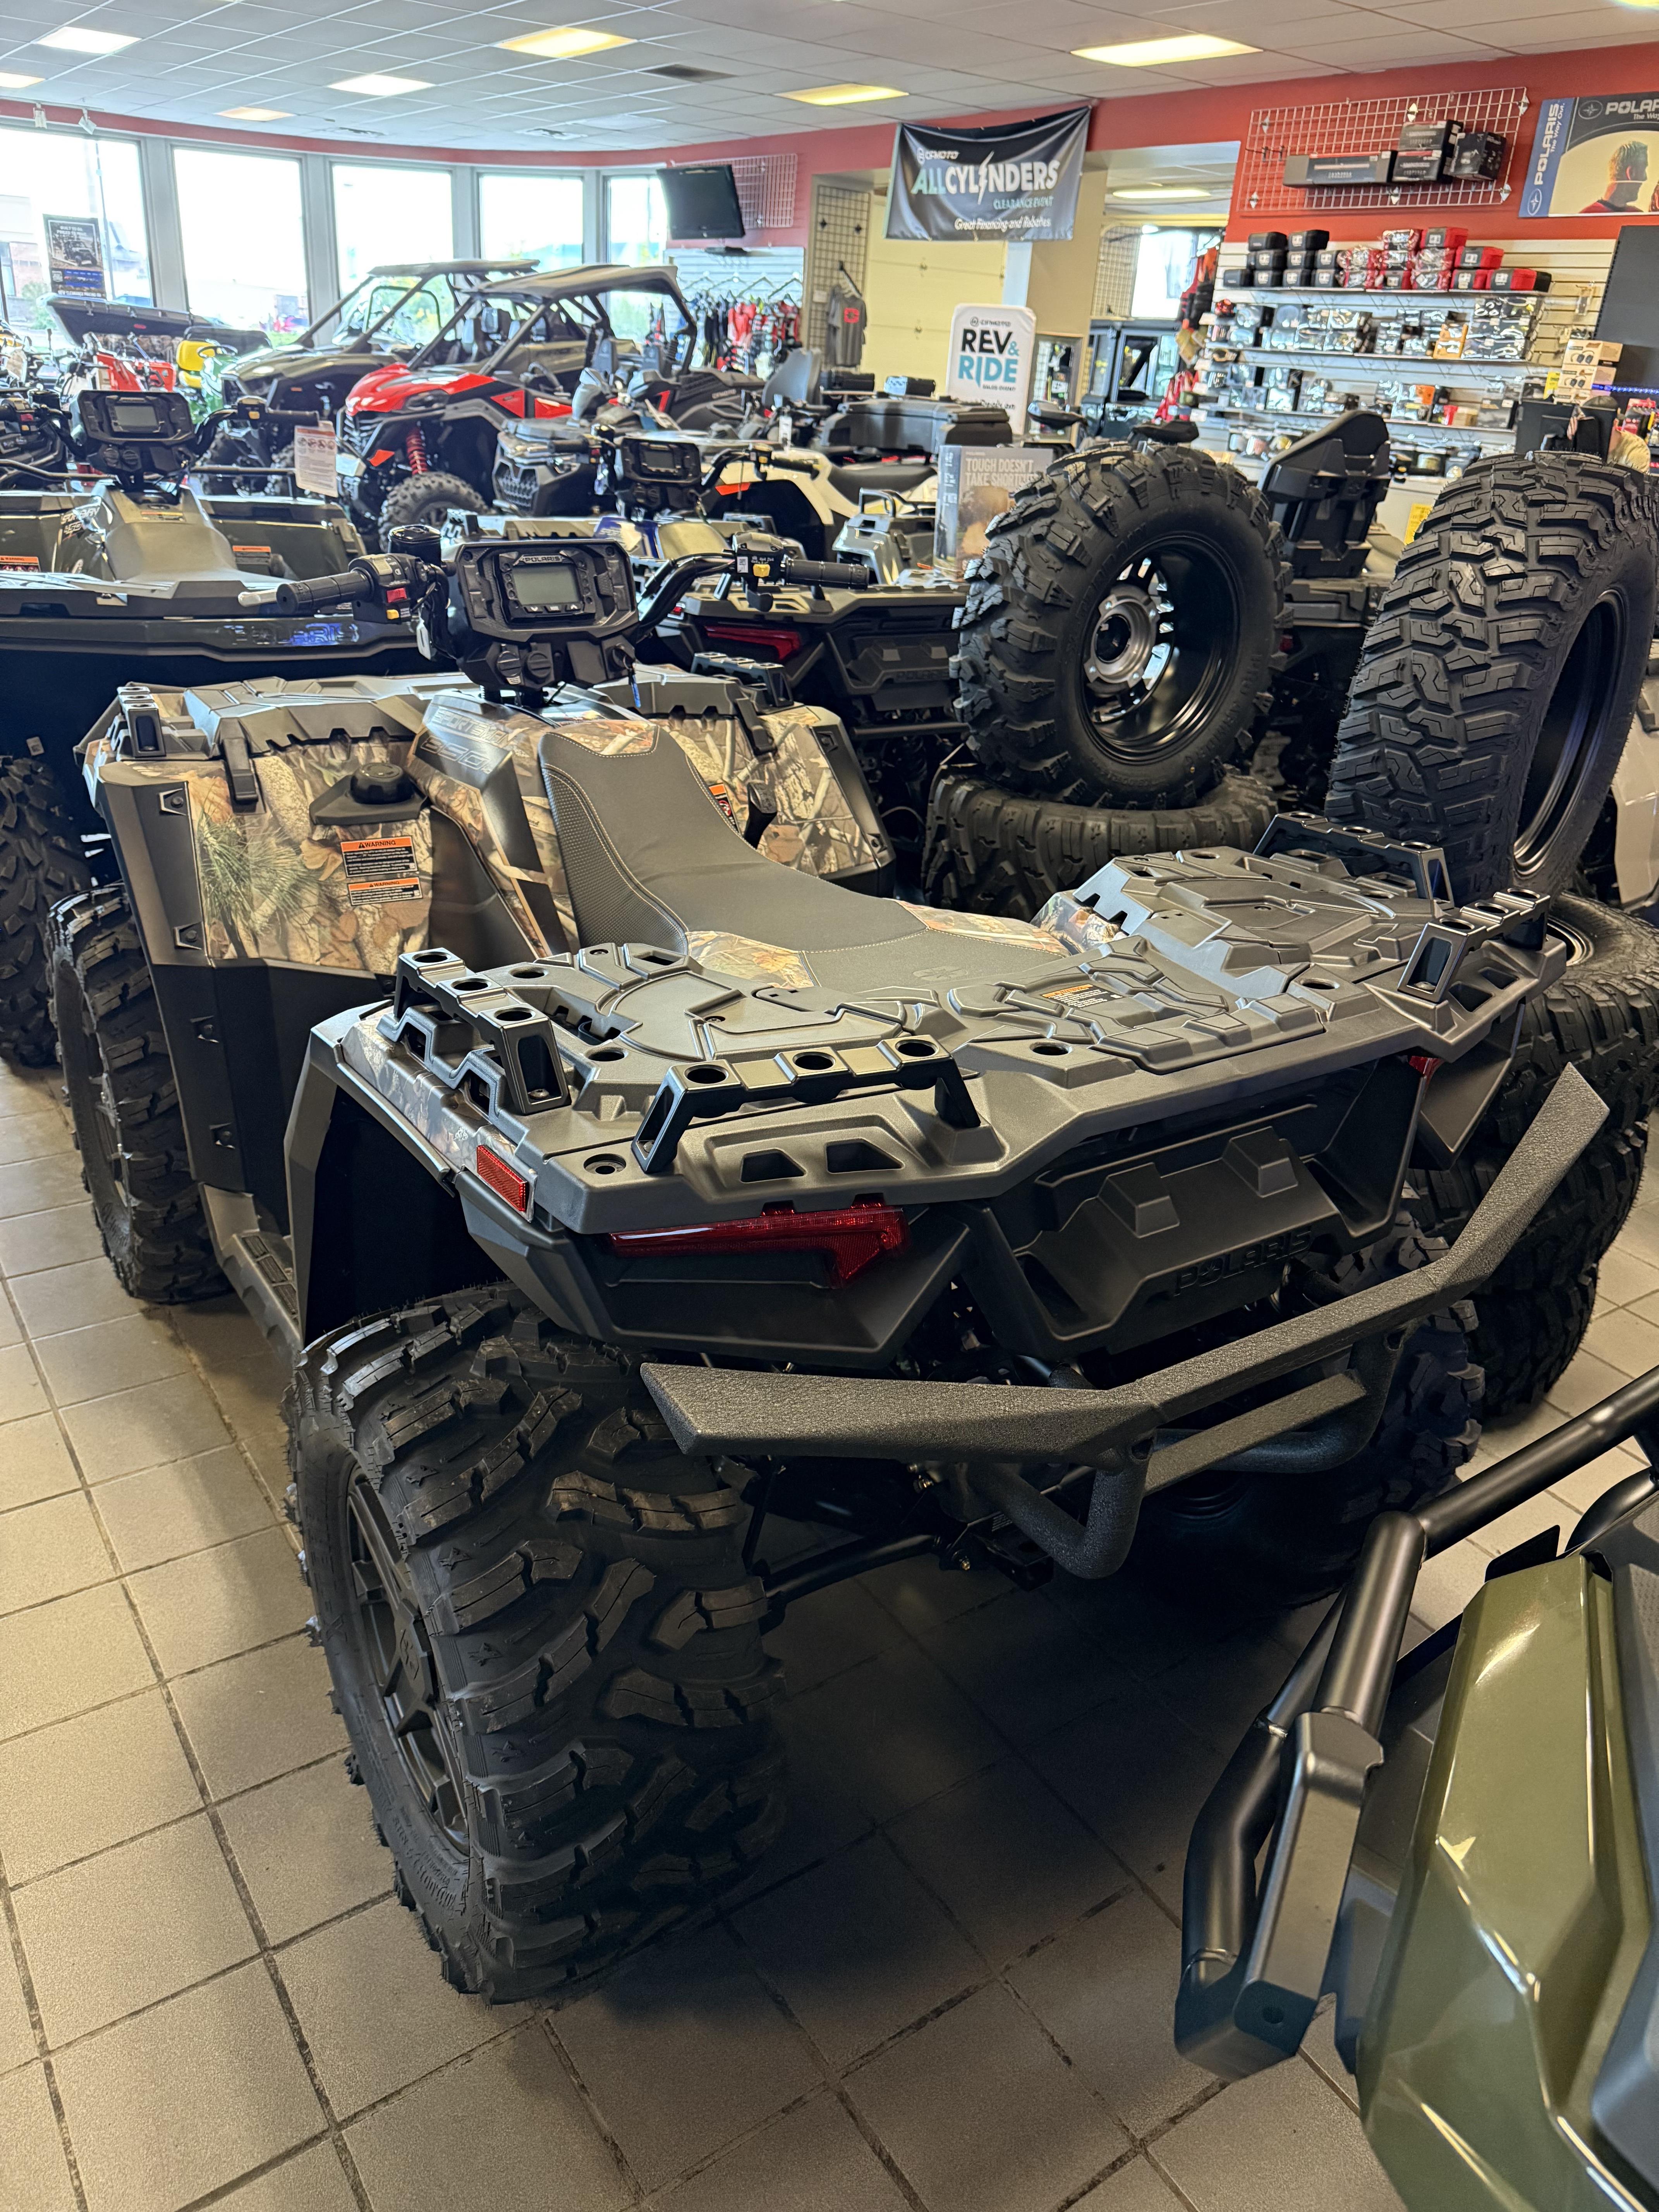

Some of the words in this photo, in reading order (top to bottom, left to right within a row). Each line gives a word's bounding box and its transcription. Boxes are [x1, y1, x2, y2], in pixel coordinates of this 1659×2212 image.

[1534, 103, 1559, 185] POLARIS
[961, 328, 1013, 354] REV
[1007, 341, 1019, 356] &
[958, 355, 1018, 388] RIDE
[965, 458, 997, 472] TOUGH
[965, 472, 990, 486] TAKE
[431, 706, 508, 748] SPORTSMAN
[420, 736, 490, 770] 850
[1173, 1224, 1312, 1297] POLARIS
